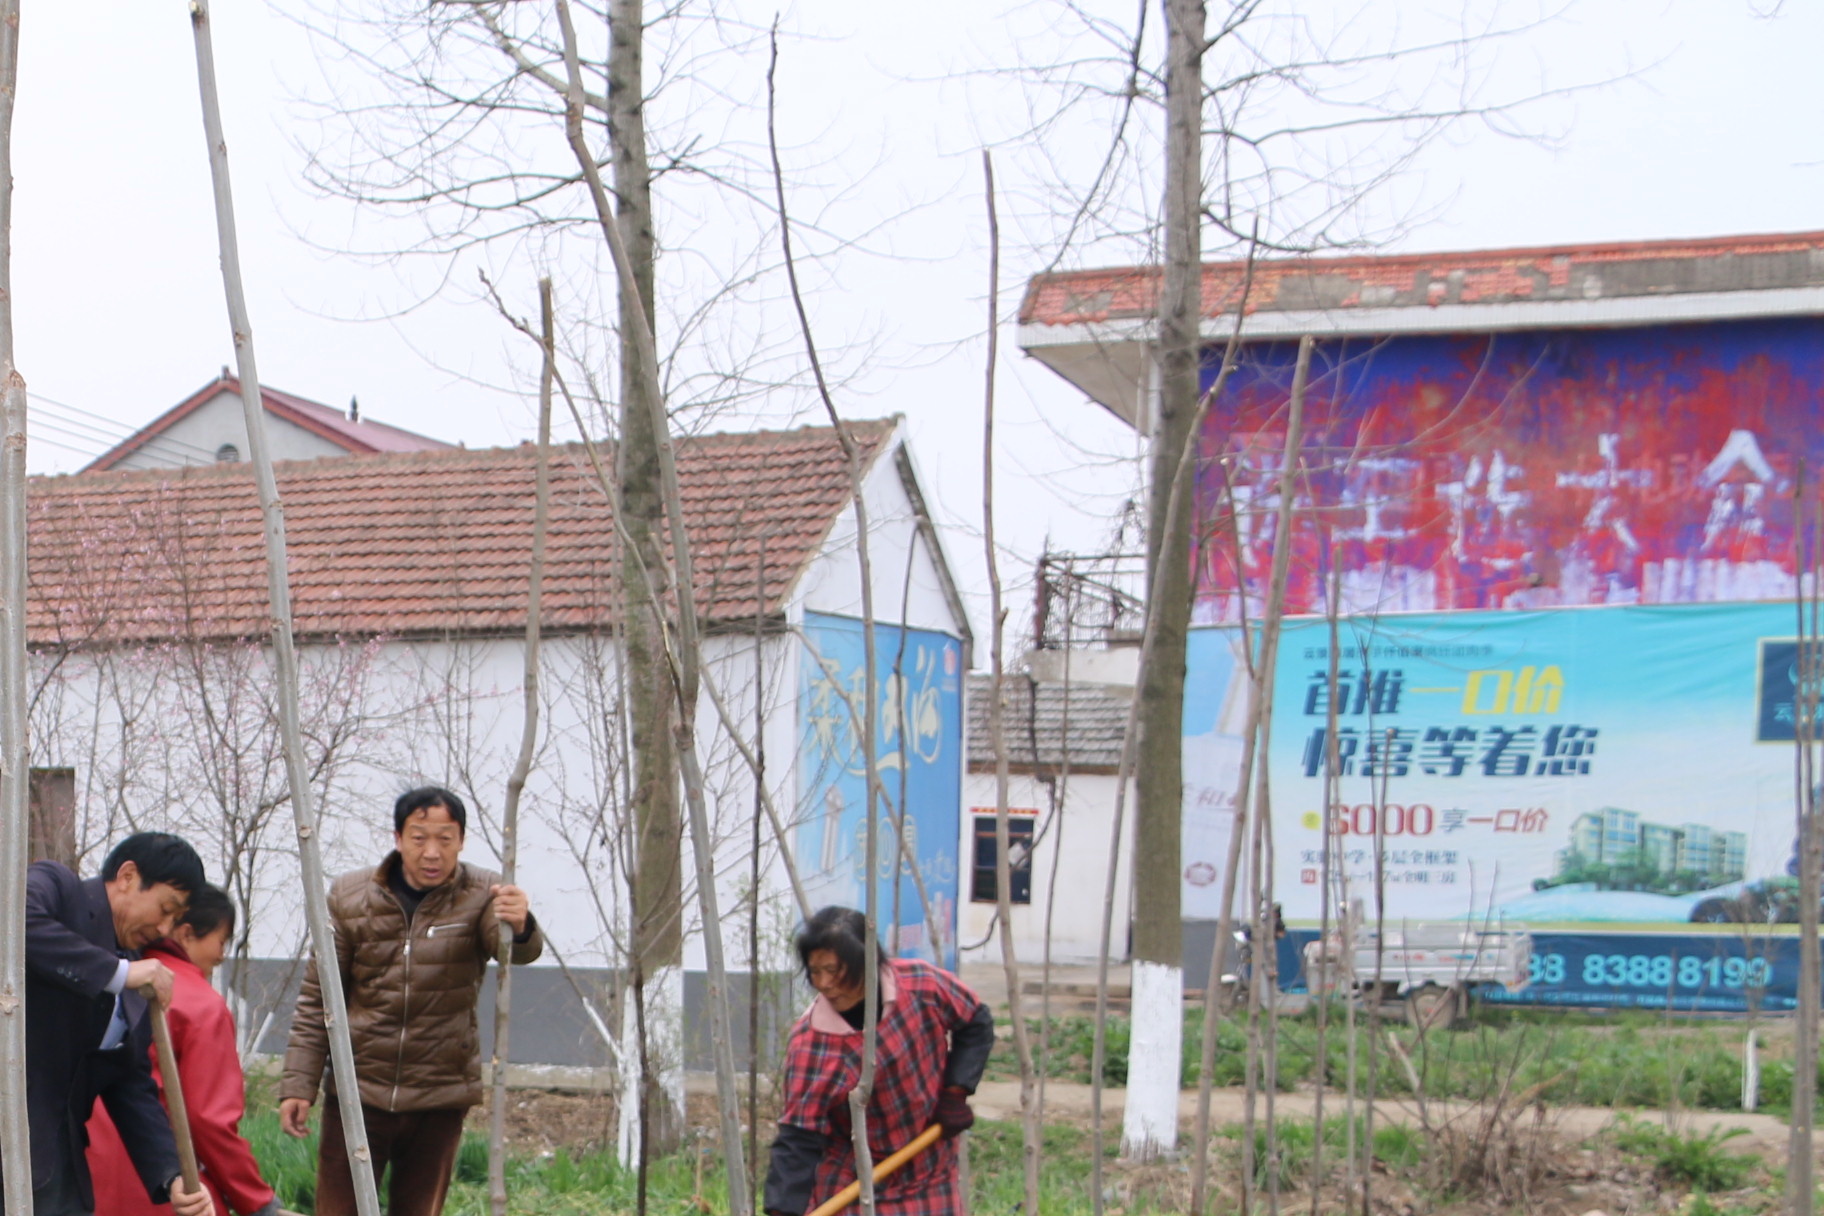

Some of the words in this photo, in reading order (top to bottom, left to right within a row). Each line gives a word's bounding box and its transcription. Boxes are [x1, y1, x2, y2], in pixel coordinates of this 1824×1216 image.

[1301, 723, 1599, 778] 惊喜等着您
